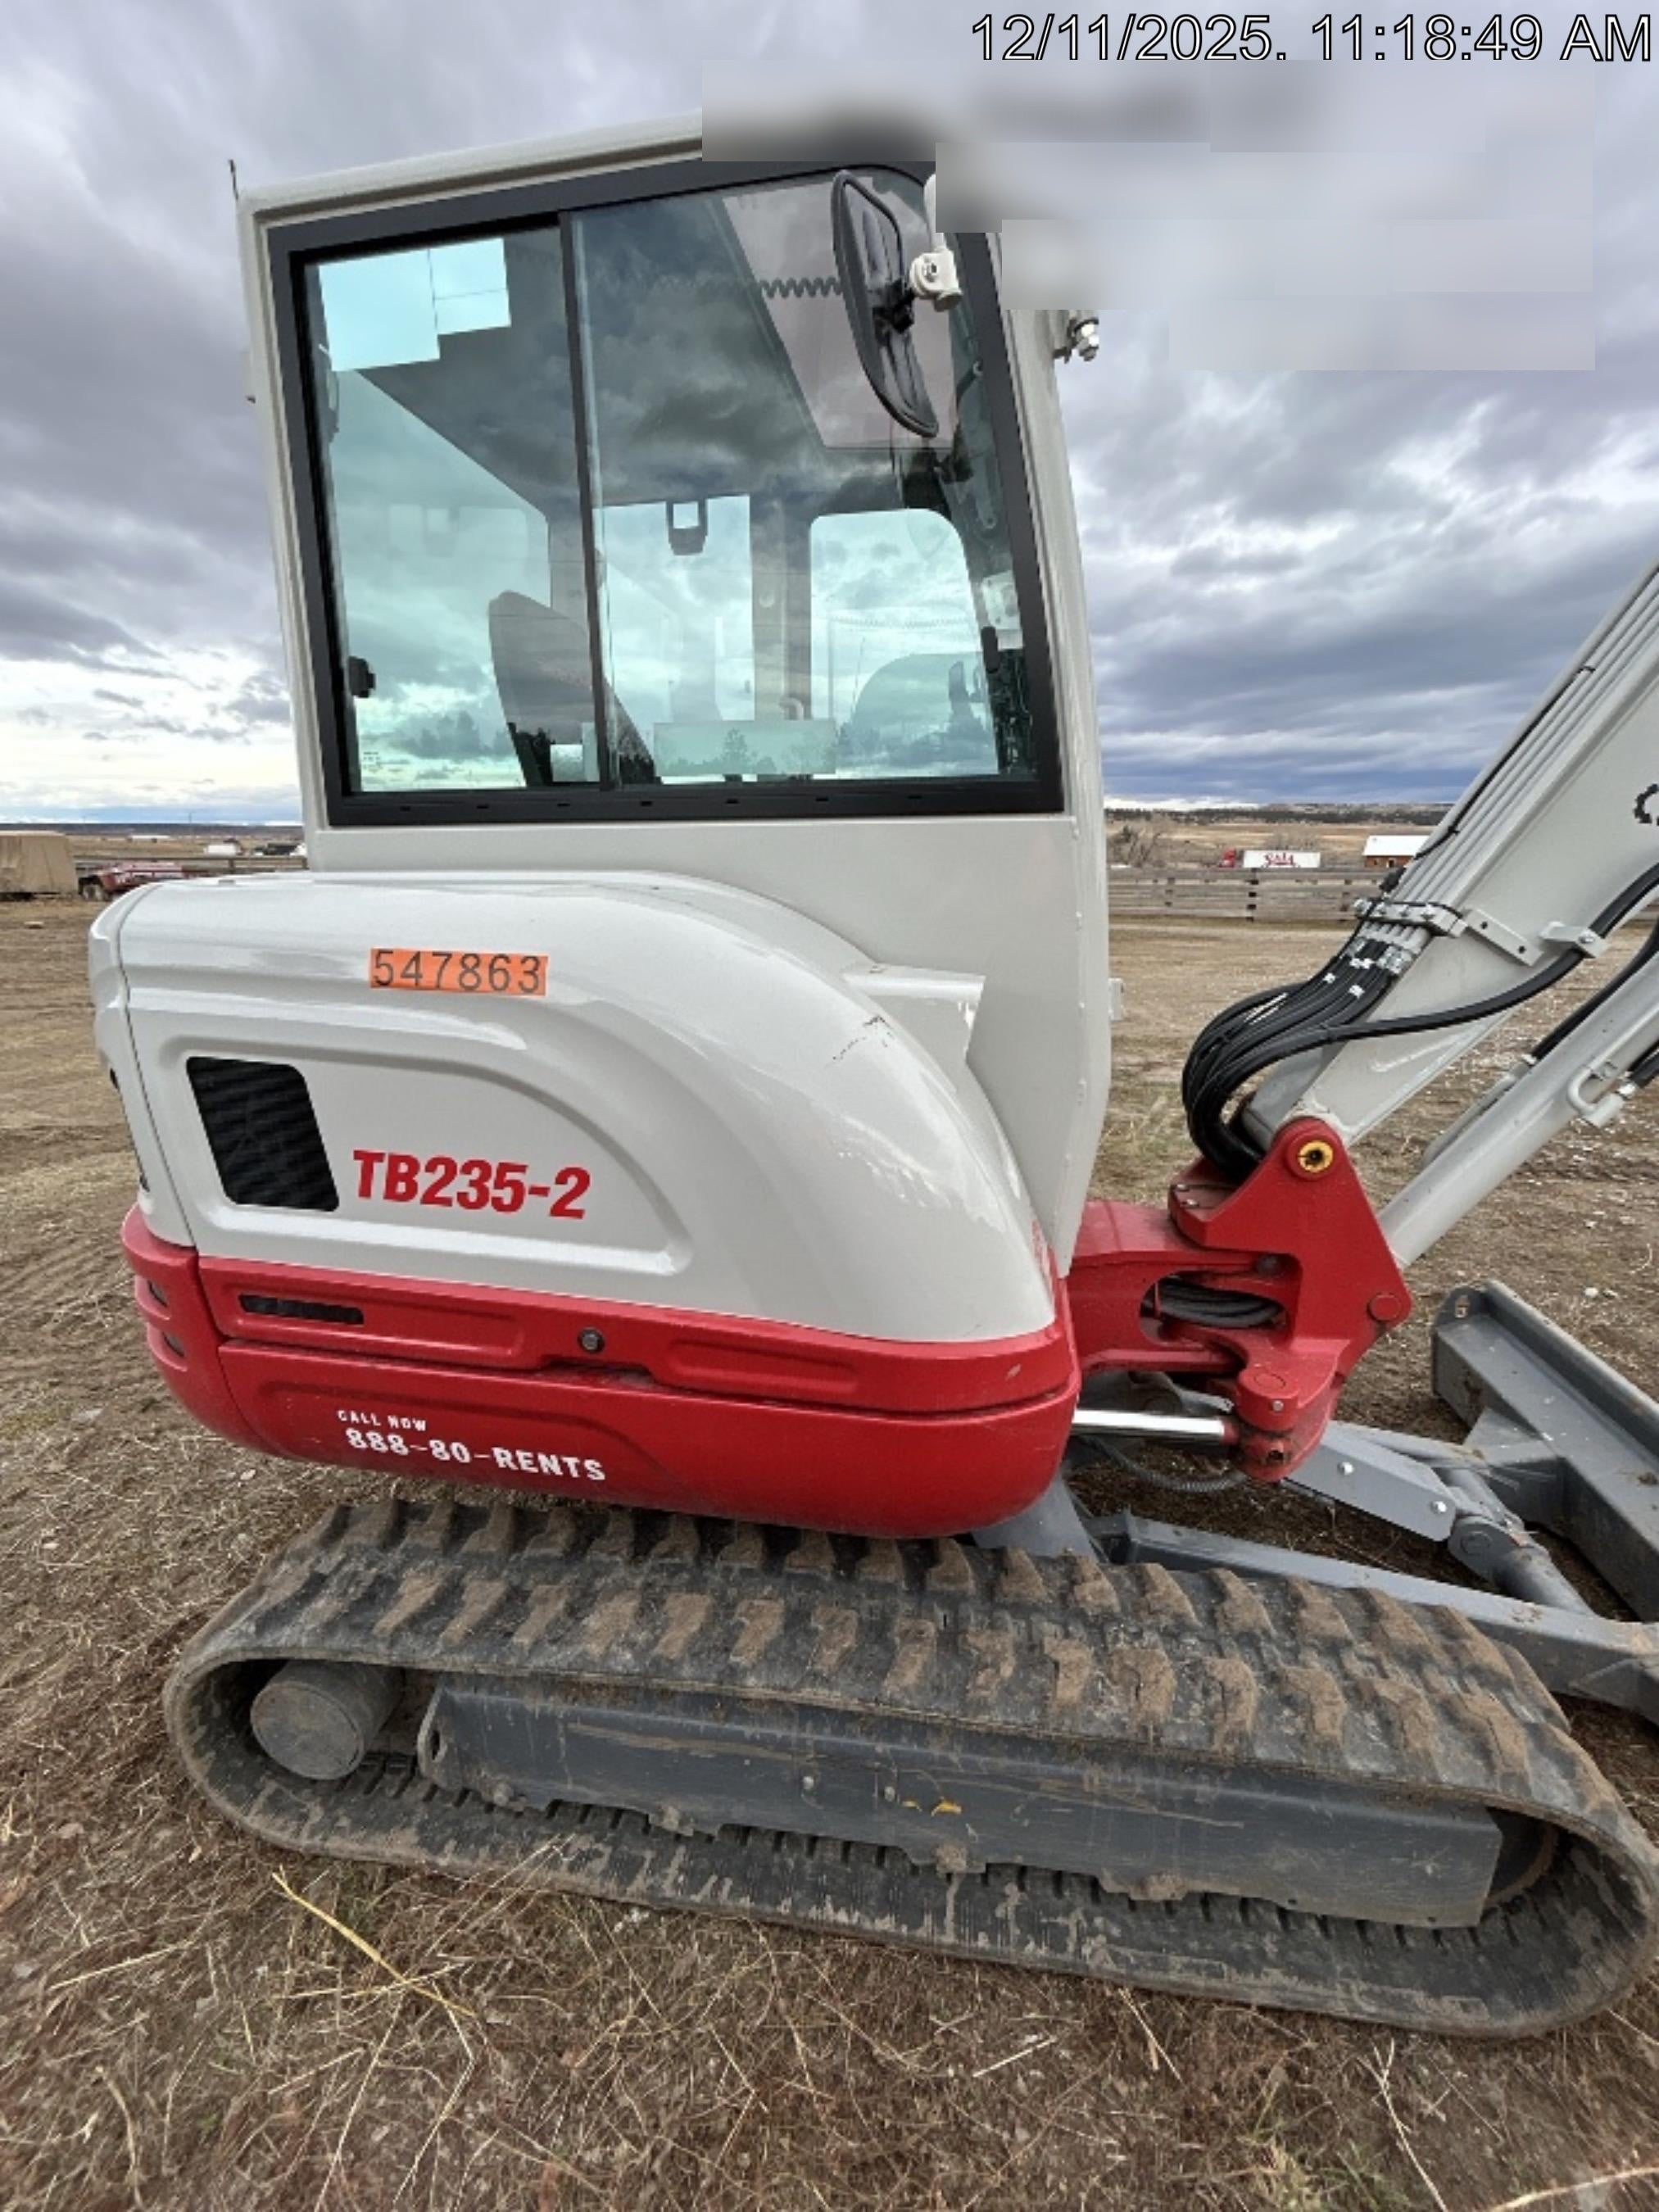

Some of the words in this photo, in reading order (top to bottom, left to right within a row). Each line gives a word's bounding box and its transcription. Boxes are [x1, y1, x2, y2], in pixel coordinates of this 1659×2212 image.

[374, 949, 541, 993] 547863
[353, 1149, 590, 1218] TB235-2
[338, 1410, 380, 1426] CALL
[388, 1415, 426, 1431] NOW
[346, 1427, 605, 1480] 888-80-RENTS
